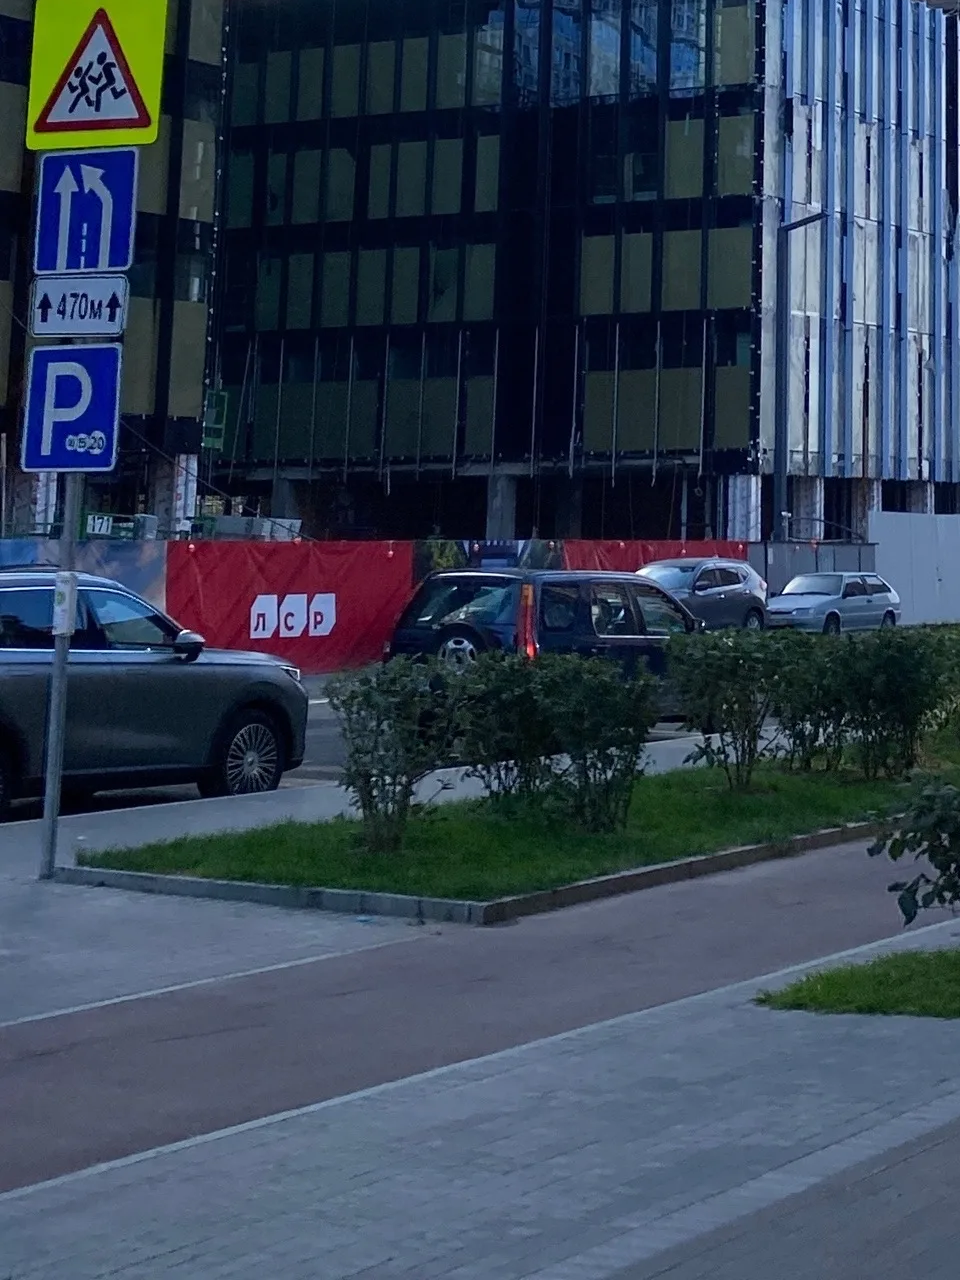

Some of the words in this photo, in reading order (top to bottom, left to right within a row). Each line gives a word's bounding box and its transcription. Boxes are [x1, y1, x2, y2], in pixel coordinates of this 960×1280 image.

[41, 361, 92, 456] P
[88, 436, 104, 450] 20
[92, 515, 110, 533] 171
[253, 611, 324, 632] ЛСР
